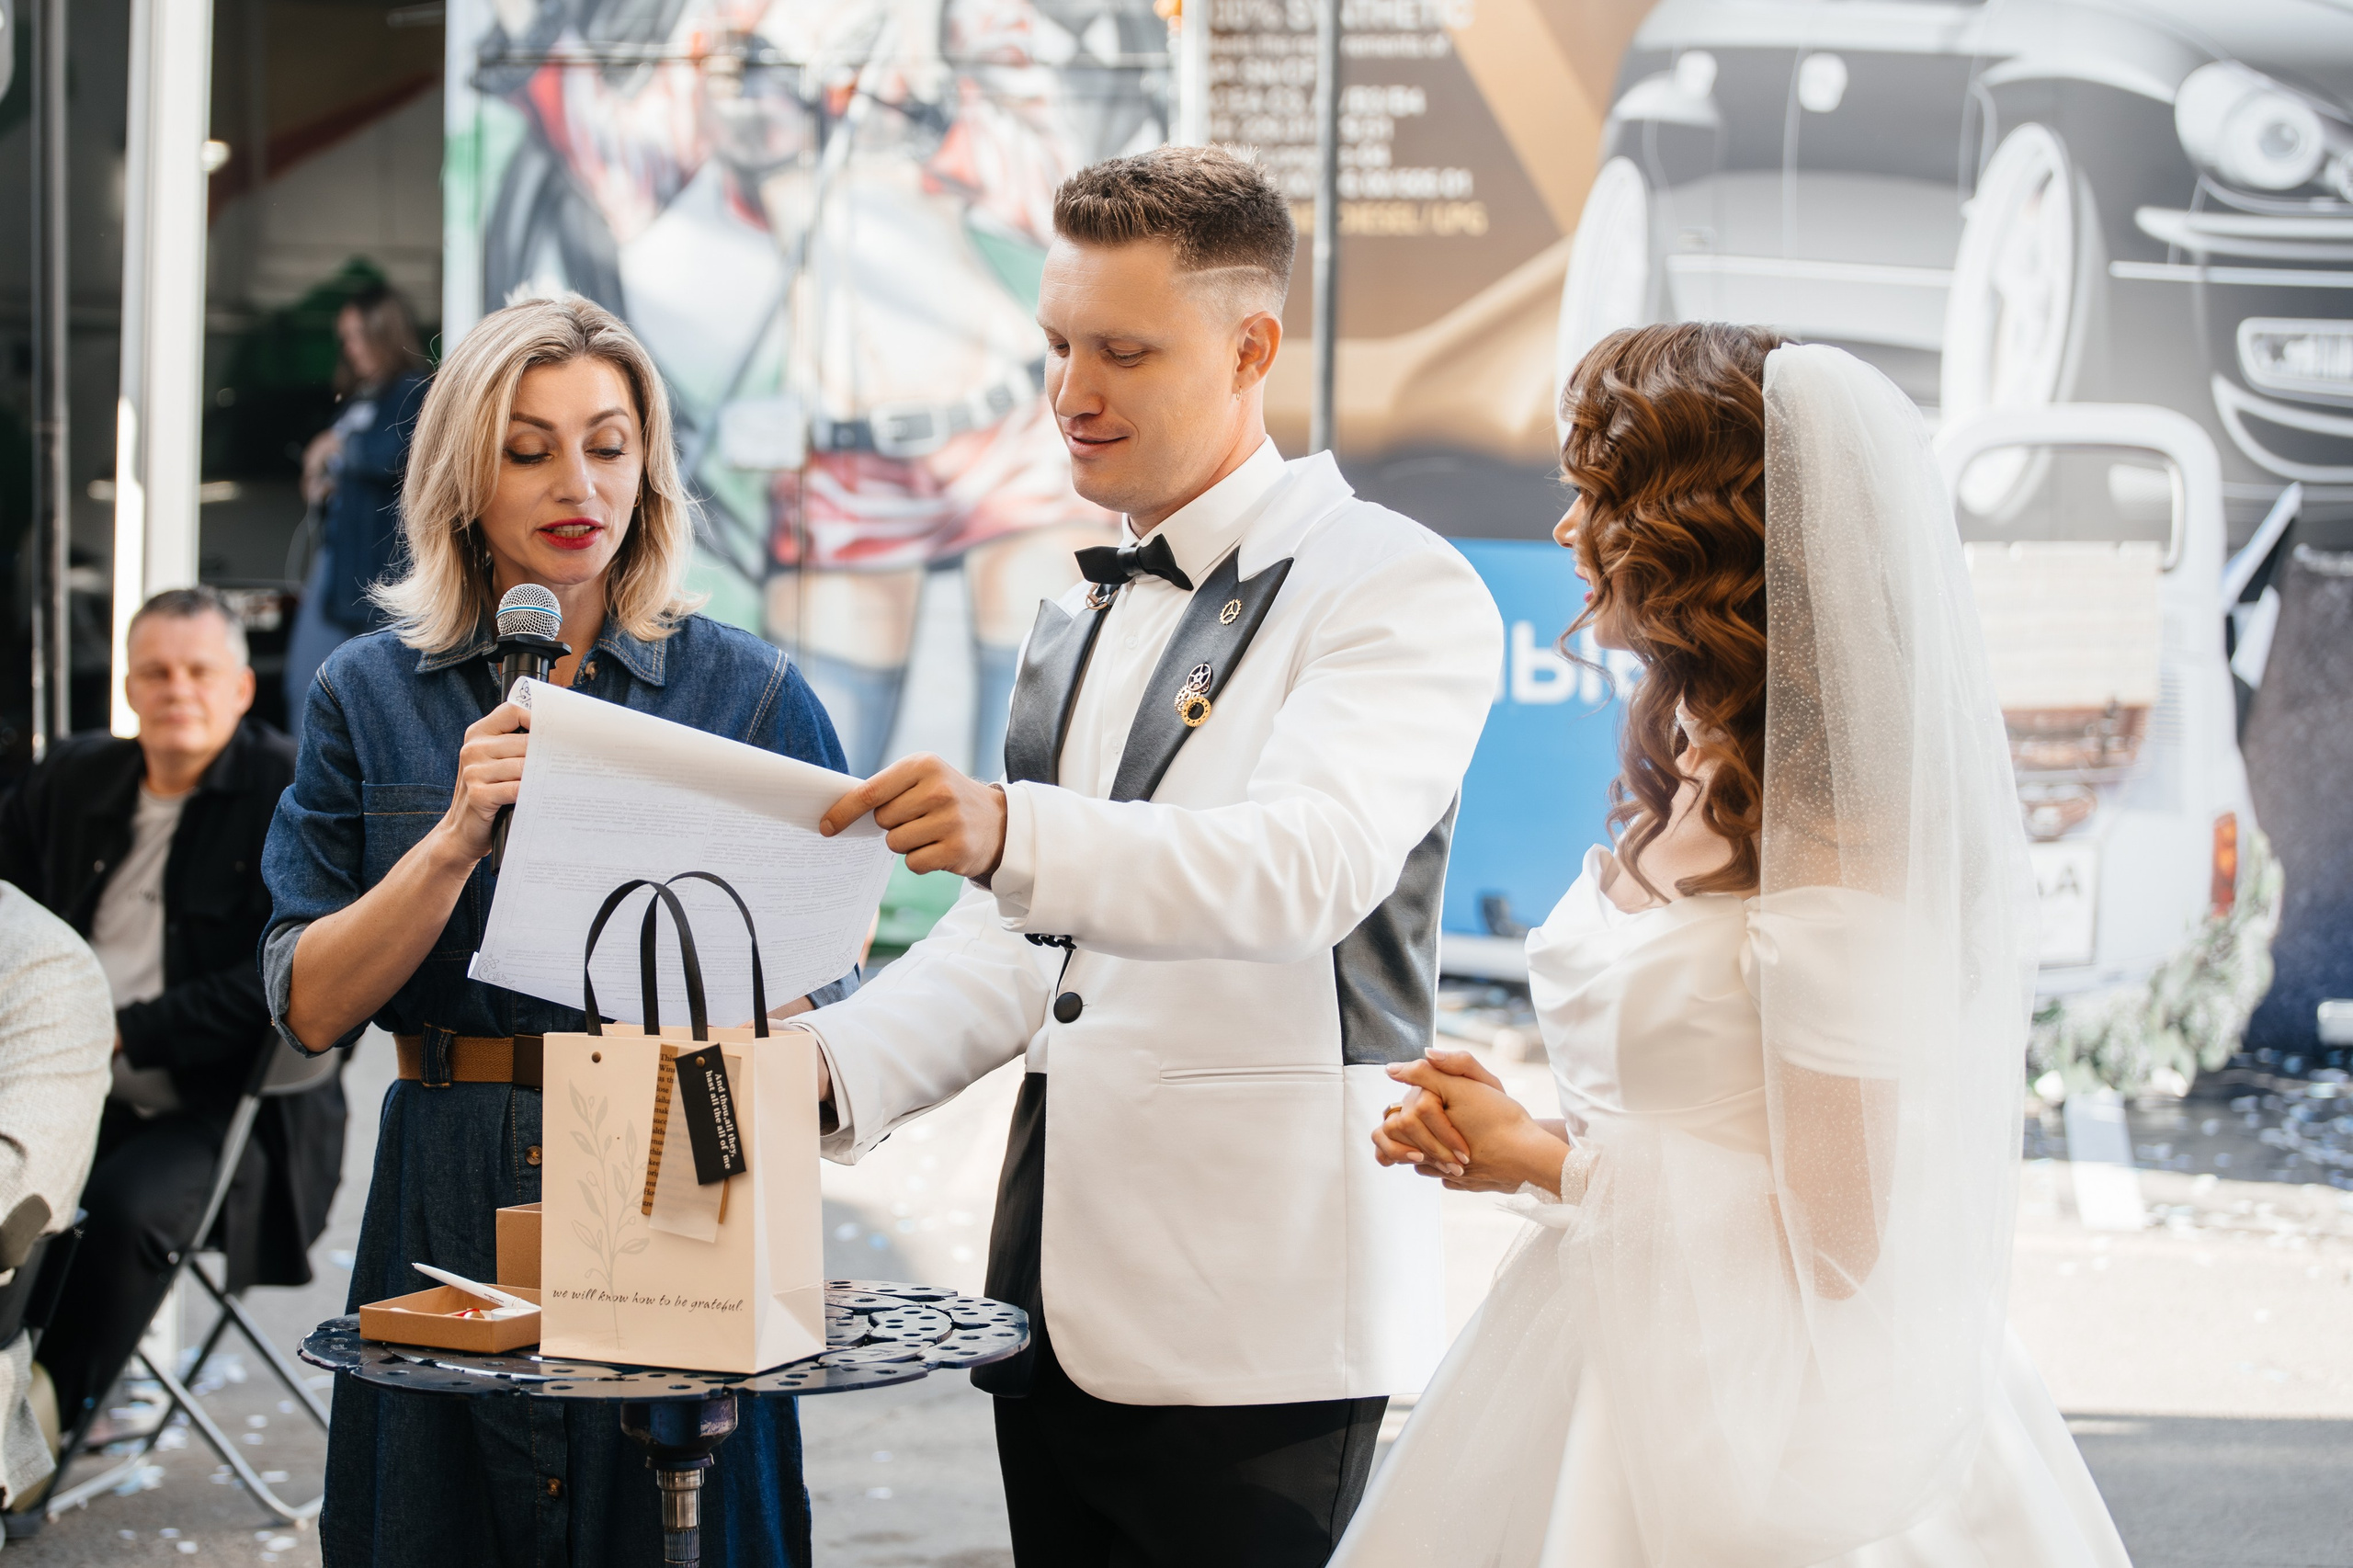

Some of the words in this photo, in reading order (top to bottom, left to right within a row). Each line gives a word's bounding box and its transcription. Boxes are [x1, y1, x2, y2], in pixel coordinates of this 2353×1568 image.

[705, 1070, 716, 1092] hast
[714, 1074, 726, 1093] And
[710, 1093, 720, 1106] all
[713, 1107, 722, 1124] the
[717, 1124, 726, 1139] all
[720, 1140, 729, 1151] of
[722, 1154, 731, 1170] me
[552, 1290, 568, 1298] we
[571, 1288, 597, 1301] will
[597, 1290, 629, 1303] know
[631, 1291, 655, 1305] how
[659, 1294, 671, 1306] to
[674, 1295, 688, 1307] be
